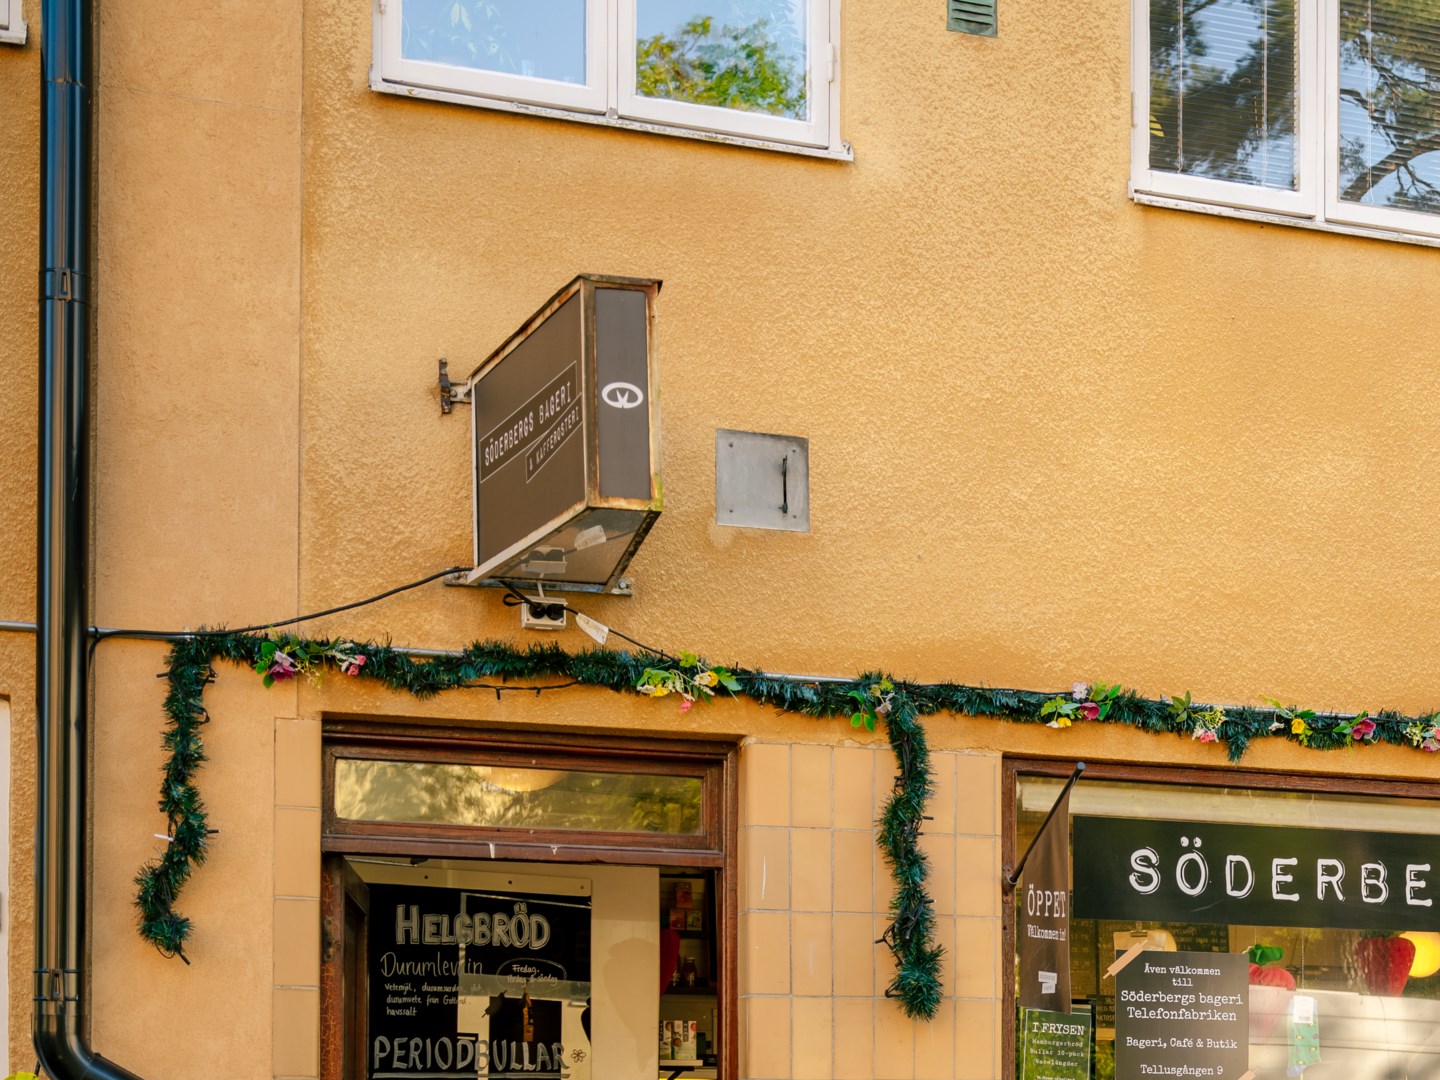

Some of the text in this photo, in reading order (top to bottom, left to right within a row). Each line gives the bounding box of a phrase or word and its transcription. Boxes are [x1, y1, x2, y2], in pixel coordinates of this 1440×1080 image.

[485, 381, 571, 466] SÖDERBERGS BAGERI
[536, 406, 579, 464] KAFFEROSTERI
[1028, 884, 1066, 918] ÖPPET
[1028, 924, 1059, 939] Välkommen
[1144, 963, 1221, 976] Även välkommen
[1172, 977, 1193, 987] till
[1121, 990, 1243, 1007] Söderbergs bageri
[1127, 1006, 1237, 1021] Telefonfabriken
[1032, 1022, 1085, 1035] I FRYSEN
[1126, 1037, 1237, 1049] Bageri, Café & Butik
[374, 1036, 570, 1071] PERIODBULLAR
[1140, 1064, 1223, 1077] Tellusgången 9
